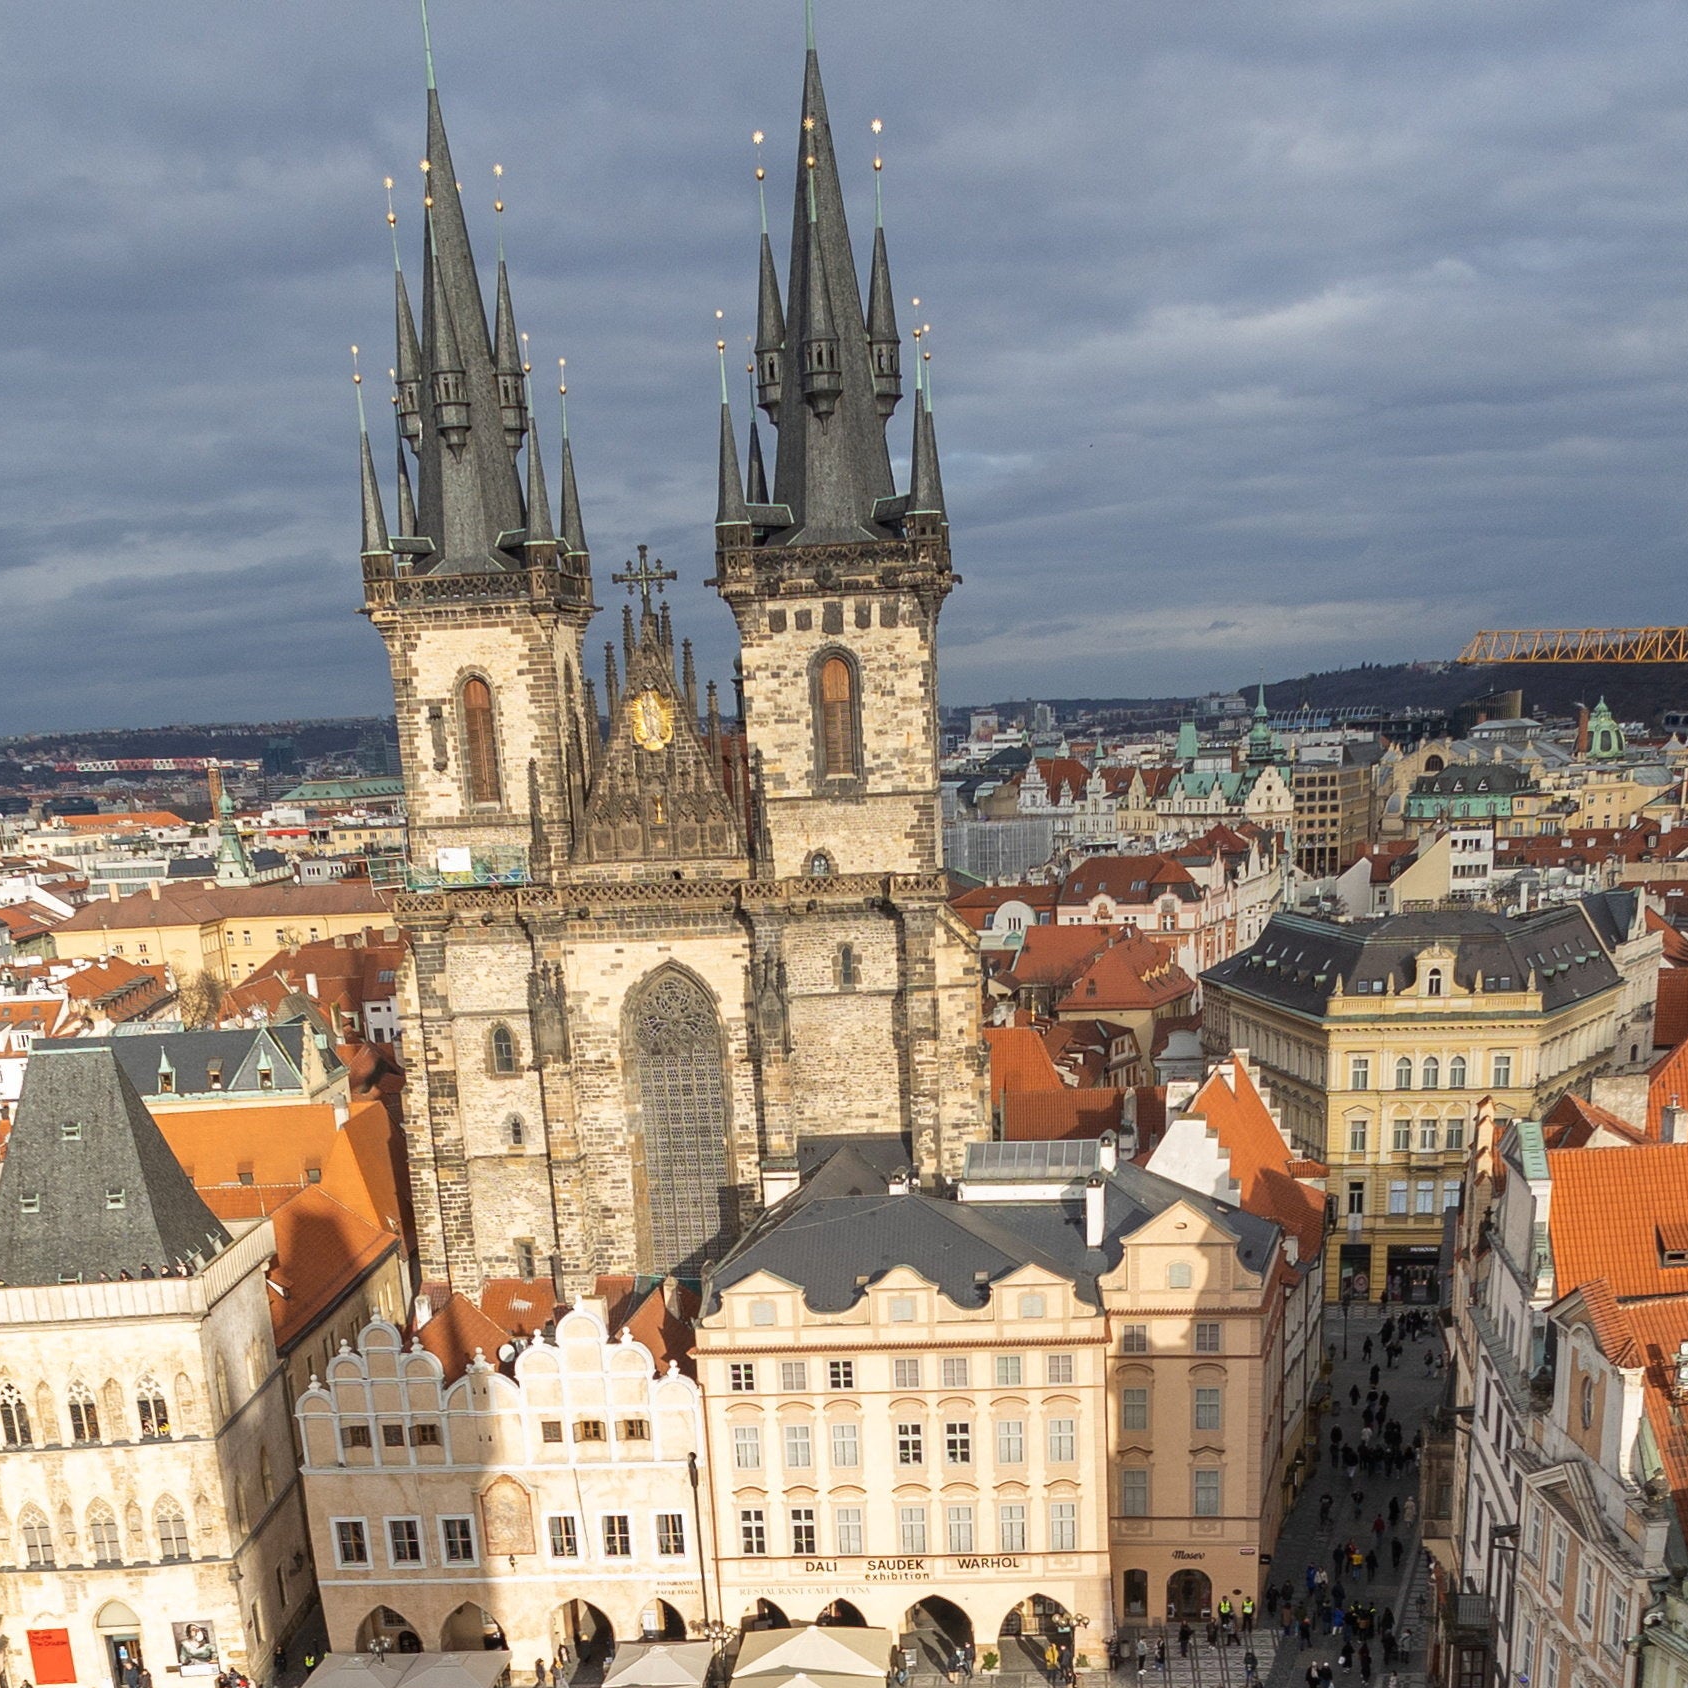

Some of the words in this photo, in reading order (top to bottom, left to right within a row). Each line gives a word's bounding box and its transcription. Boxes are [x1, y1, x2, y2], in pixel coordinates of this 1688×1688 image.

[1172, 1550, 1206, 1560] Moser
[805, 1559, 838, 1573] DALÍ
[867, 1559, 925, 1571] SAUDEK
[957, 1557, 1020, 1569] WARHOL
[865, 1572, 930, 1581] exhibition
[739, 1588, 804, 1596] RESTAURANT
